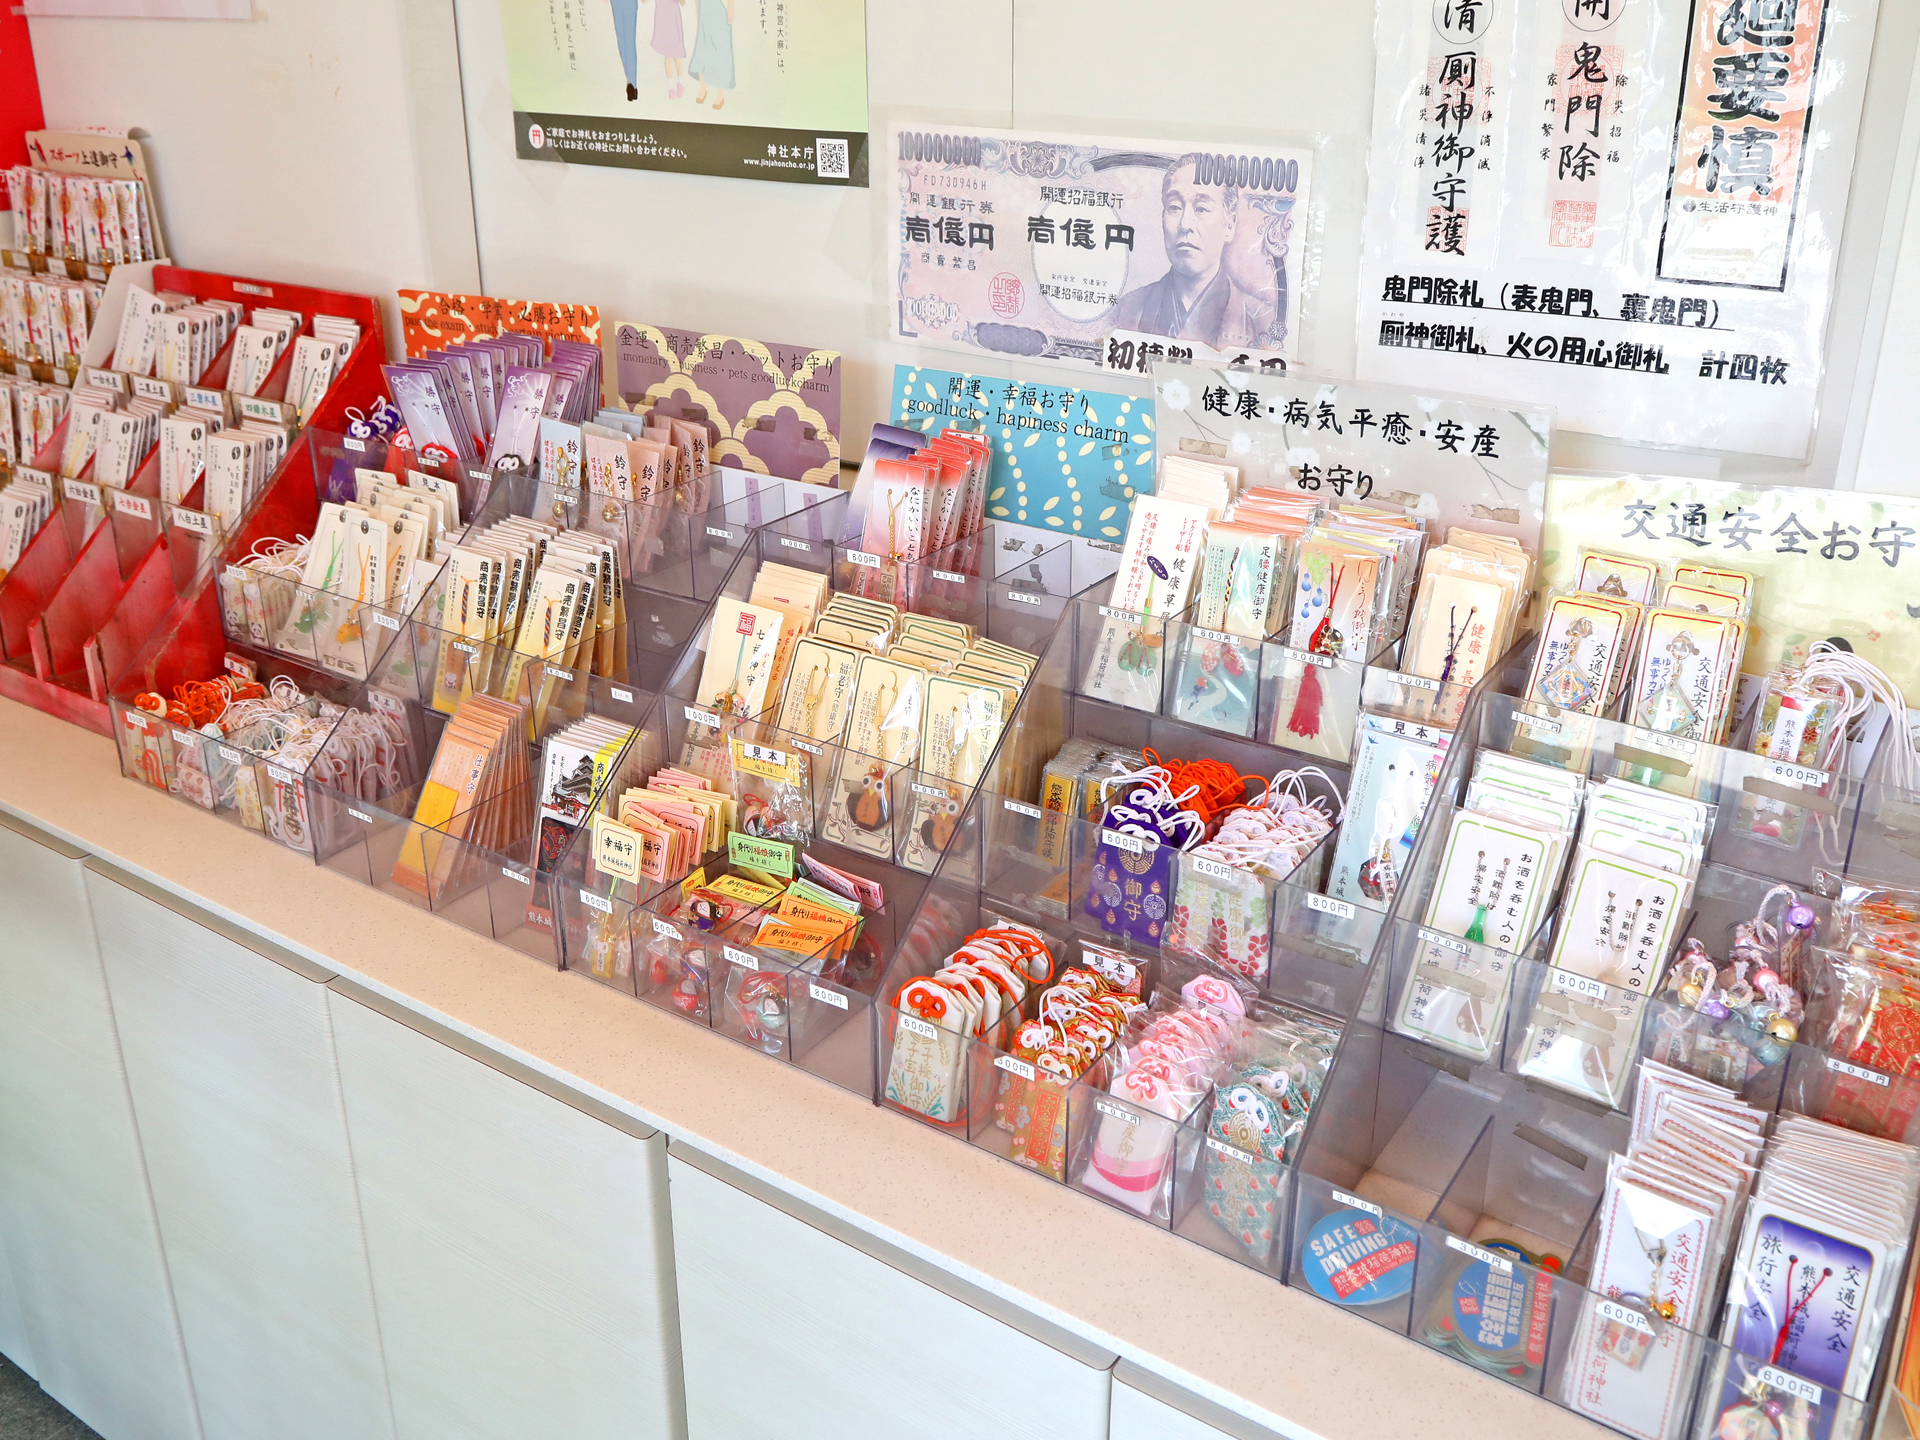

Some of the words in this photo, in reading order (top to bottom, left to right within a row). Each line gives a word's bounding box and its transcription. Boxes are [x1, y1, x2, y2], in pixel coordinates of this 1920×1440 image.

[1558, 42, 1609, 182] 鬼門除
[546, 127, 658, 145] ご家庭でお神札をおまつりしましょう。
[546, 138, 689, 160] 詳しくはお近くの神社にお問い合わせください。
[767, 144, 814, 160] 神社本庁
[743, 157, 816, 171] www.jinjahoncho.or.jp
[923, 175, 987, 191] FD730946H
[909, 191, 995, 215] 開運銀行券
[1040, 186, 1124, 210] 開運招福銀行
[1697, 201, 1779, 217] 生活守護神
[905, 215, 995, 252] 壱億円
[1027, 215, 1135, 252] 壱億円
[1039, 283, 1118, 306] 開運招福銀行券
[405, 315, 422, 327] pass
[425, 317, 438, 329] the
[440, 321, 465, 332] exam
[623, 352, 669, 369] monetary
[679, 360, 718, 375] business
[728, 367, 749, 381] pets
[1698, 353, 1791, 386] 計四枚
[425, 386, 441, 416] 勝守
[530, 387, 544, 420] 勝守
[948, 376, 1091, 416] 開運・幸福お守り
[1073, 422, 1130, 444] charm
[1201, 383, 1502, 460] 健康・病気平癒・安産
[566, 439, 578, 475] 鈴守
[693, 438, 706, 474] 鈴守
[422, 477, 441, 490] 見本
[614, 454, 628, 491] 鈴守
[640, 464, 655, 502] 鈴守
[1295, 462, 1376, 502] お守り
[177, 513, 208, 530] 八白土星
[852, 553, 877, 566] 600円
[935, 571, 965, 583] 800円
[1156, 557, 1187, 638] 健康草履
[555, 583, 576, 641] 商売繁昌守
[1107, 609, 1135, 622] 800円
[1292, 652, 1325, 667] 800円
[687, 709, 717, 726] 1000円
[1393, 720, 1429, 739] 見本
[752, 746, 779, 762] 見本
[464, 753, 485, 797] 仕事守
[1775, 765, 1820, 785] 600円
[914, 785, 945, 798] 800円
[1007, 801, 1040, 818] 300円
[603, 836, 634, 857] 幸福守
[1107, 833, 1139, 851] 600円
[1198, 860, 1231, 879] 600円
[585, 894, 609, 910] 600円
[1123, 877, 1143, 922] 御守
[1313, 895, 1349, 915] 800円
[1421, 931, 1464, 953] 600円
[728, 950, 755, 968] 600円
[1093, 955, 1126, 974] 見本
[1557, 973, 1601, 997] 600円
[814, 988, 843, 1007] 800円
[904, 1018, 935, 1038] 600円
[1832, 1061, 1887, 1085] 800円
[1100, 1104, 1138, 1125] 800円
[1210, 1140, 1251, 1163] 800円
[1337, 1192, 1380, 1215] 300円
[1310, 1224, 1358, 1257] SAFE
[1319, 1232, 1389, 1276] DRIVING
[1459, 1241, 1502, 1267] 300円
[1747, 1233, 1783, 1322] 旅行安全
[1782, 1264, 1818, 1371] 熊本城稲荷神
[1825, 1264, 1862, 1354] 交通安全
[1763, 1370, 1815, 1400] 600円
